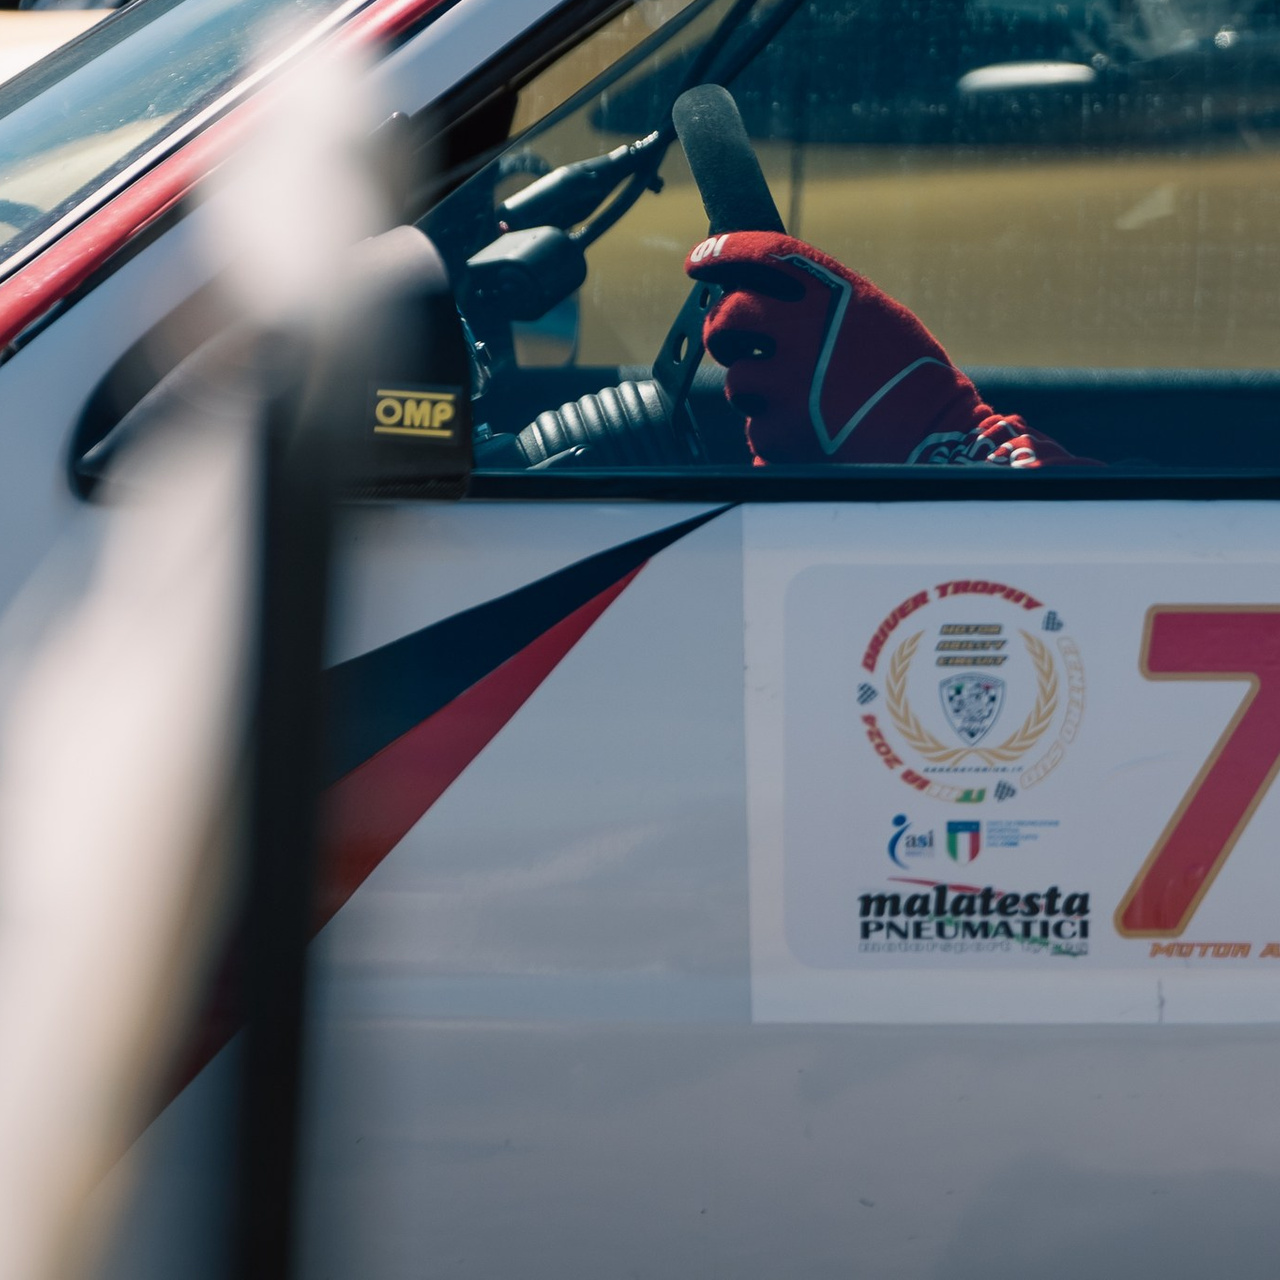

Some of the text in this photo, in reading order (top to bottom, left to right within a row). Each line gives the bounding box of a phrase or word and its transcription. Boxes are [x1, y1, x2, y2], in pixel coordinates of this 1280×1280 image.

[374, 397, 456, 428] OMP
[862, 579, 1044, 673] DRIVER TROPHY
[861, 714, 986, 804] ITALIA 2024
[905, 829, 934, 848] asi
[857, 883, 1090, 917] malatesta
[861, 919, 1090, 940] PNEUMATICI
[1149, 941, 1252, 959] MOTOR
